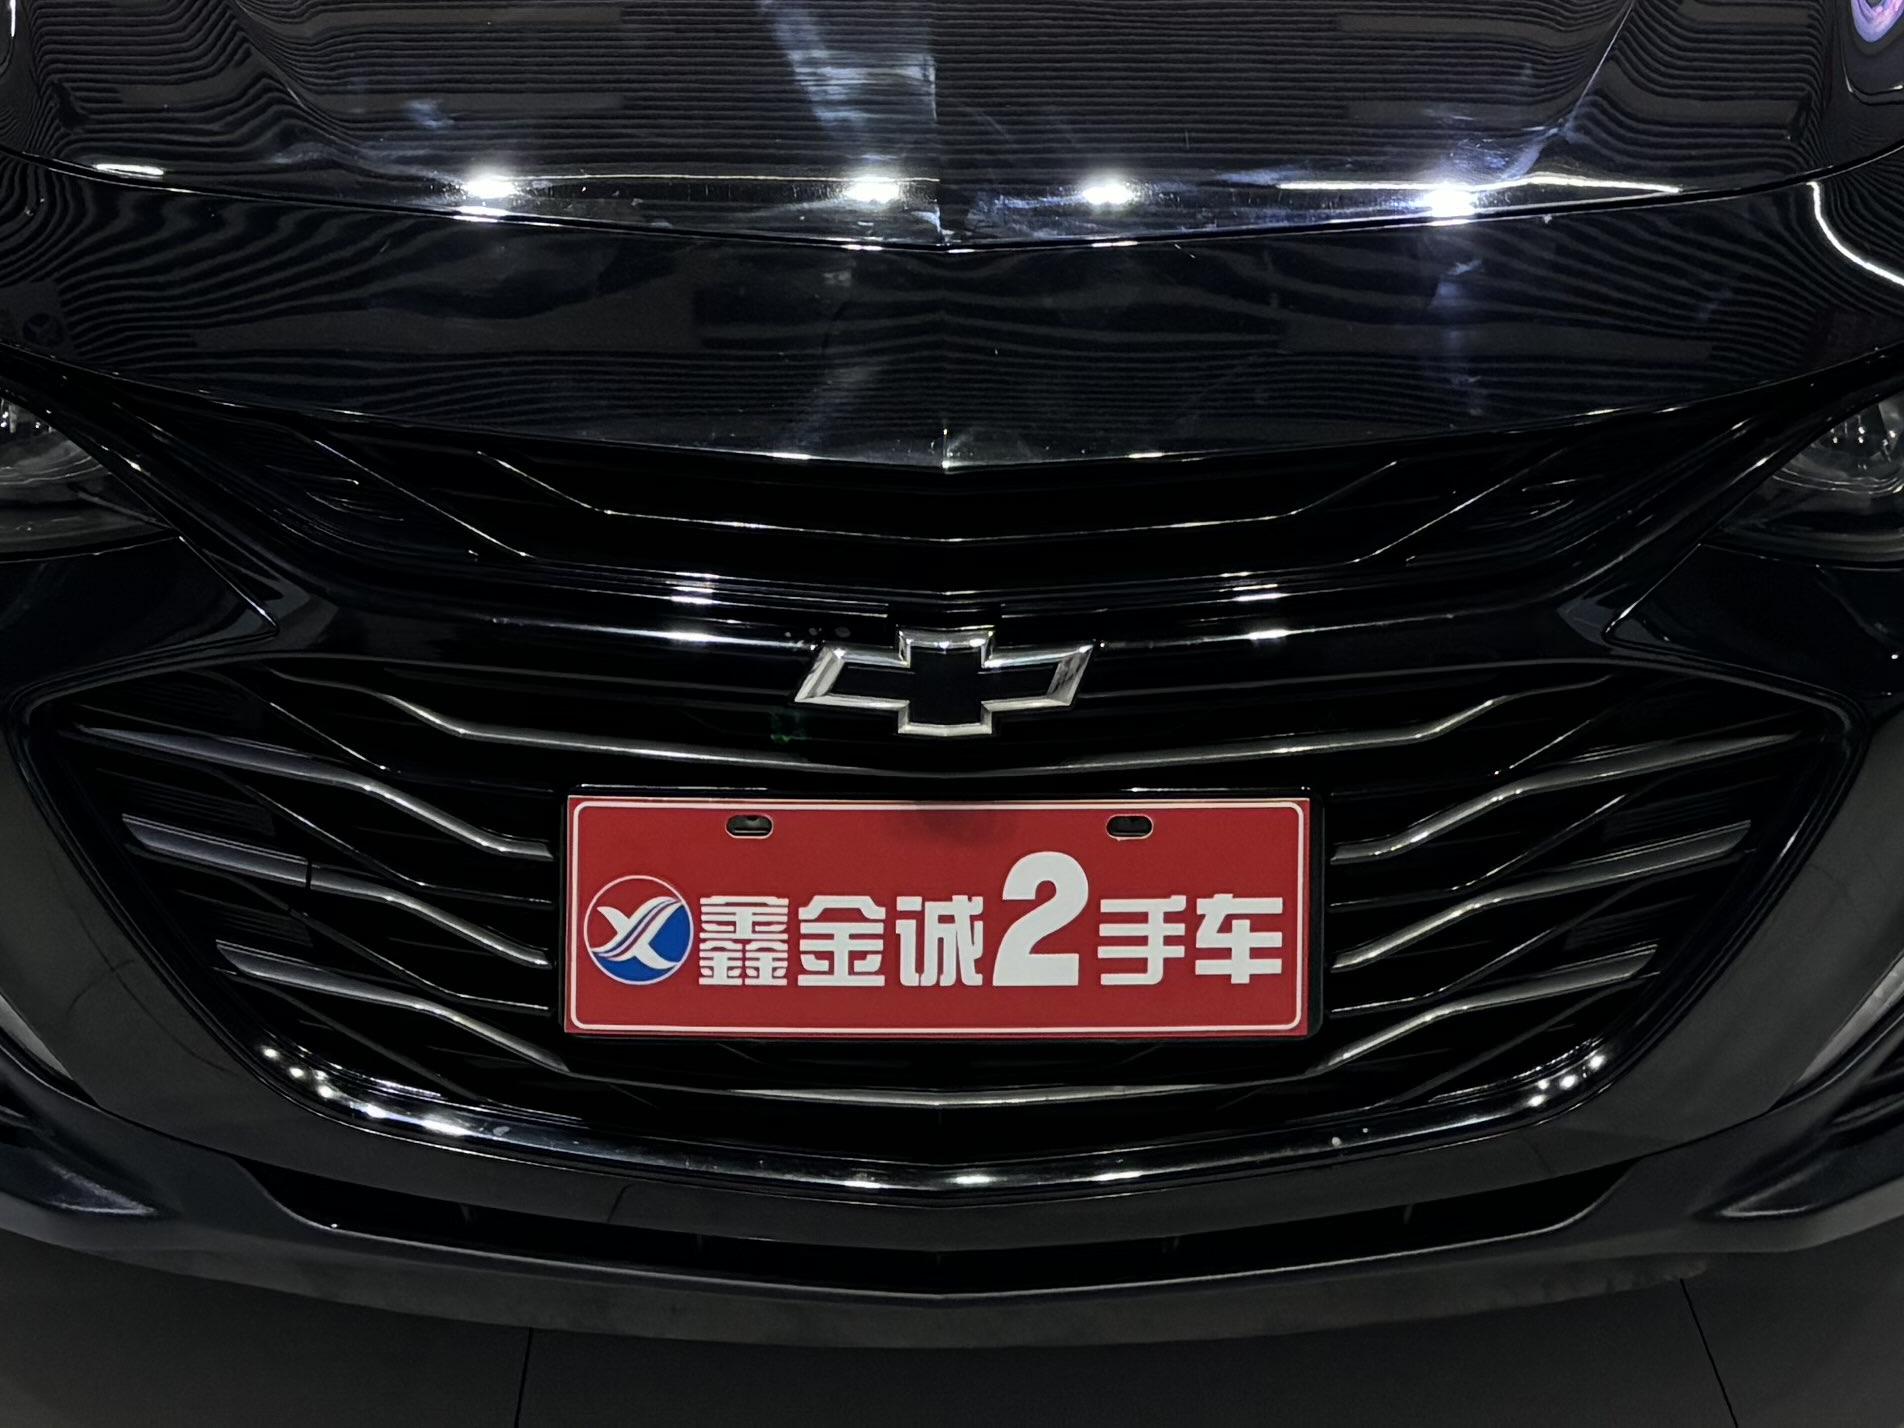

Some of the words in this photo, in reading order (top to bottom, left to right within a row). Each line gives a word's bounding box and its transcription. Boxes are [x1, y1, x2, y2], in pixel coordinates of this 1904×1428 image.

[698, 851, 1284, 988] 鑫金诚2手车
